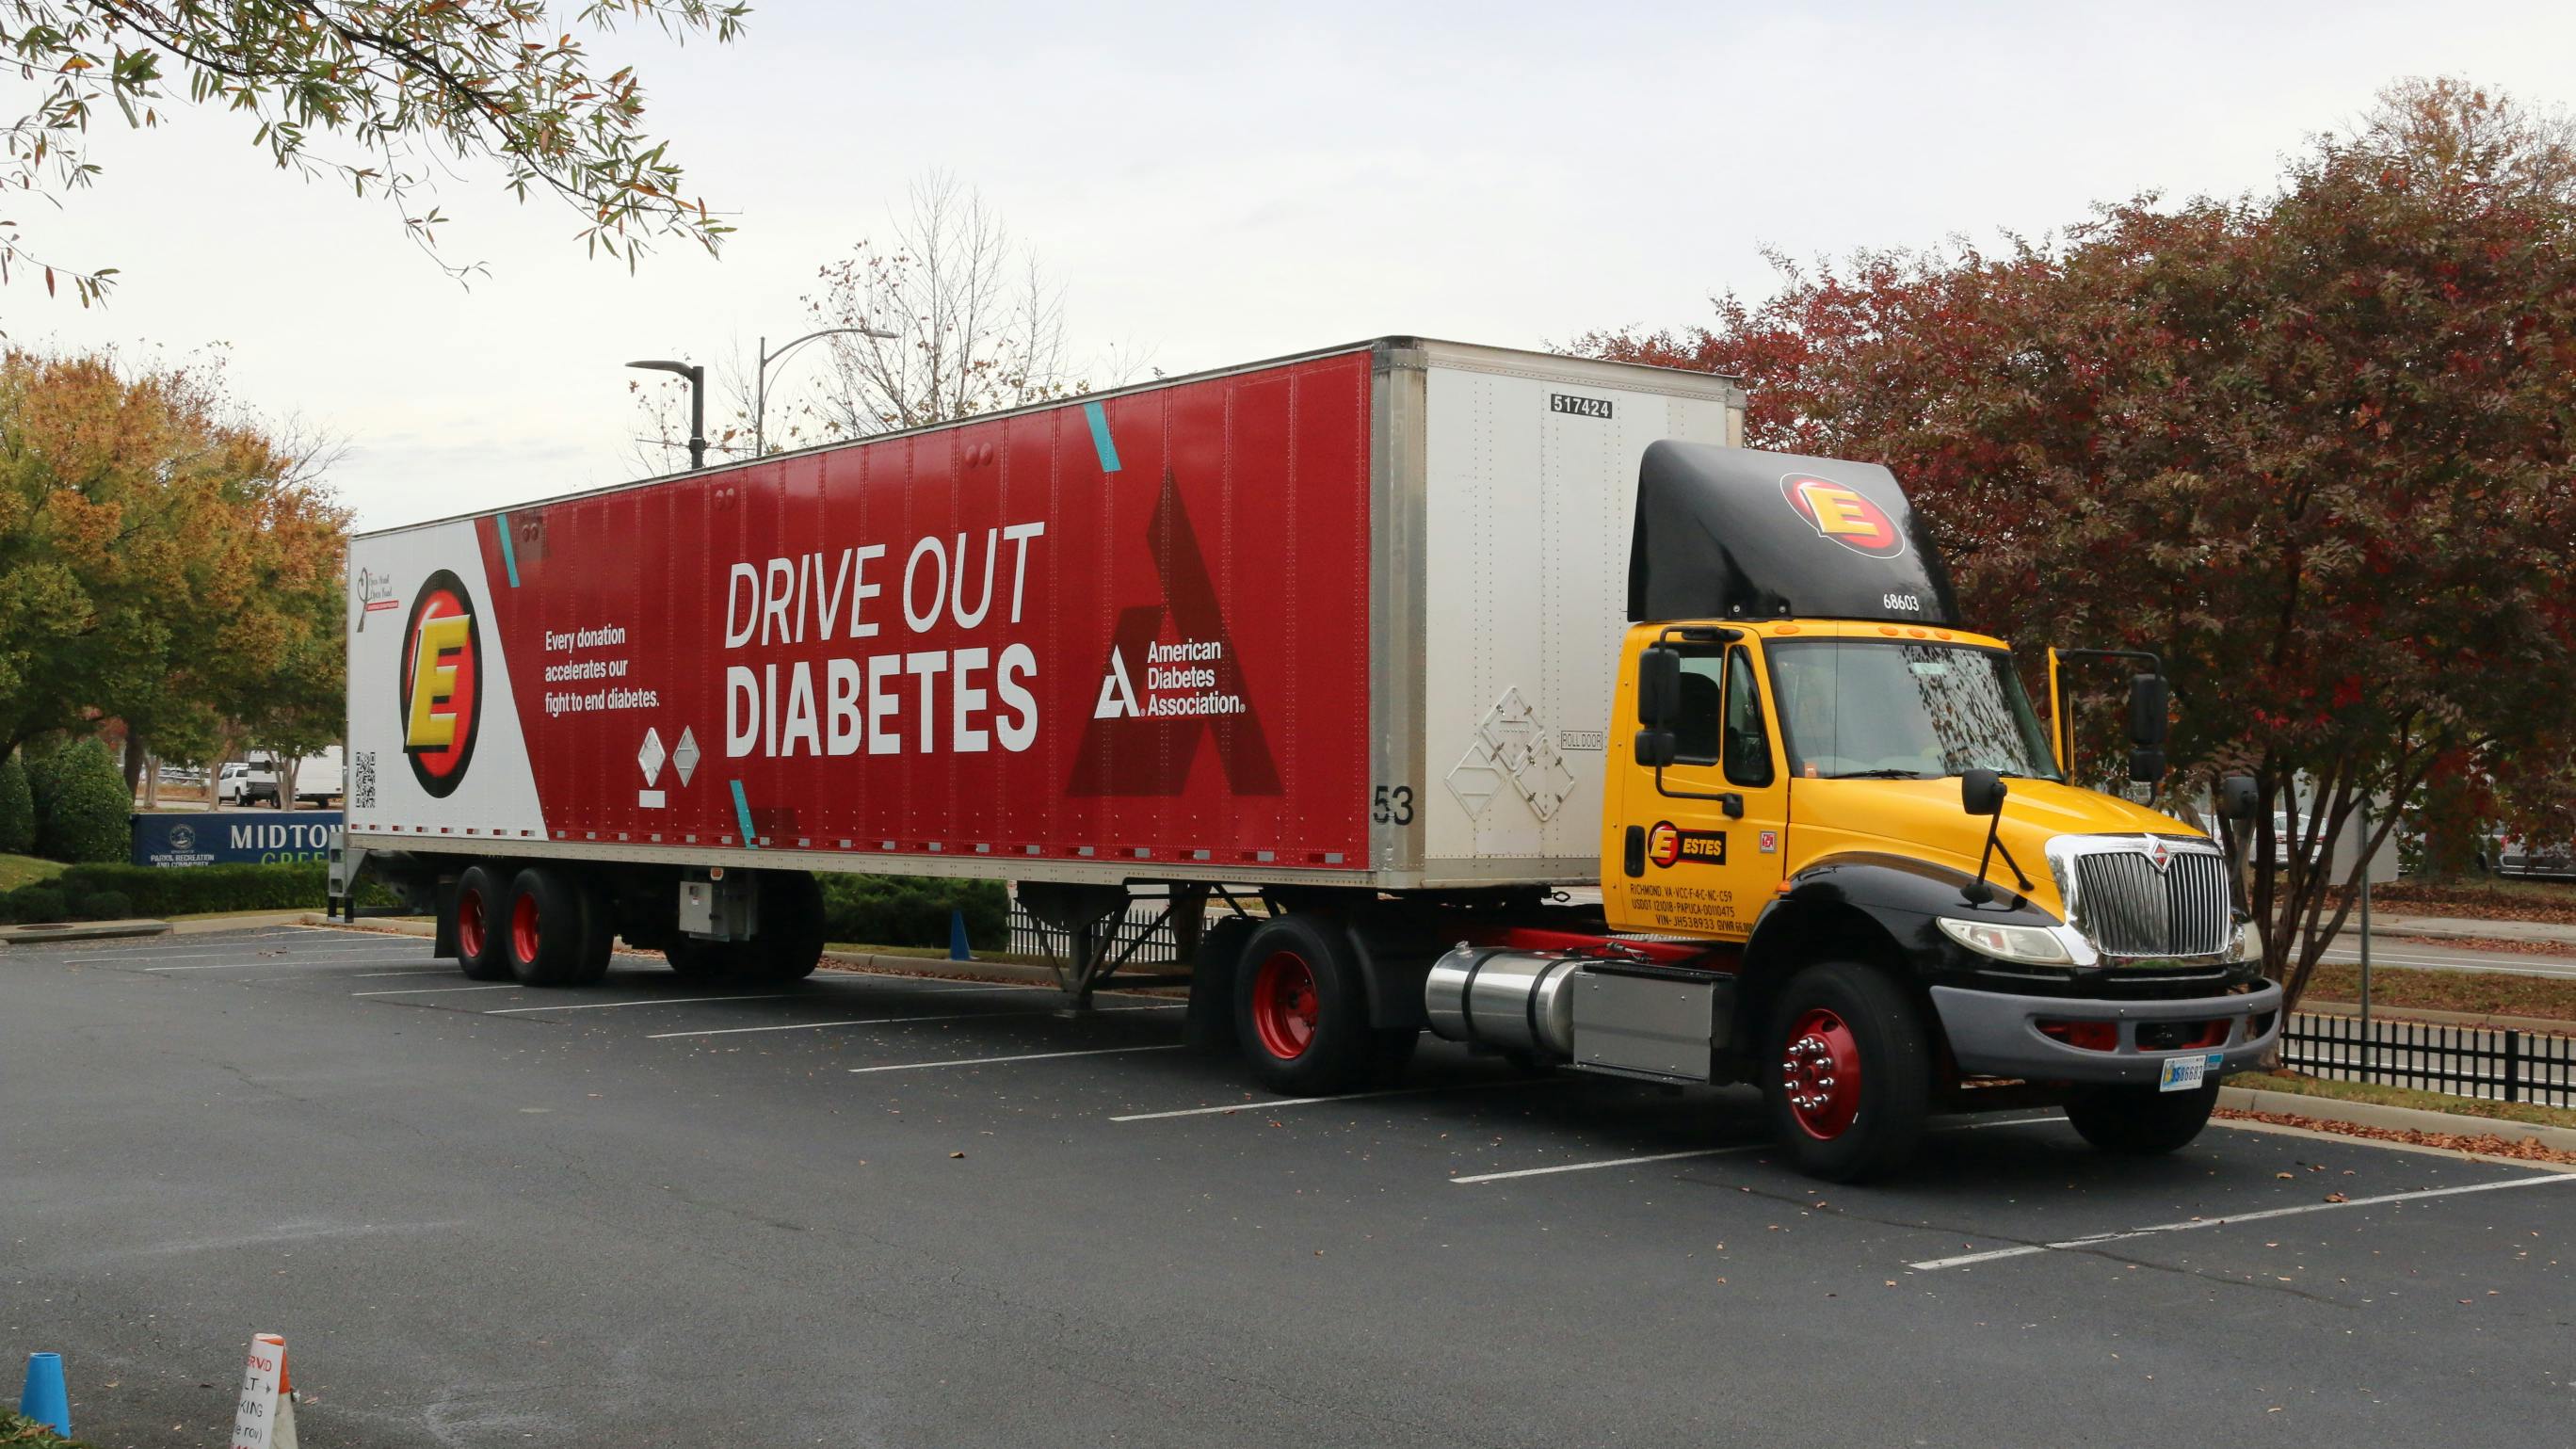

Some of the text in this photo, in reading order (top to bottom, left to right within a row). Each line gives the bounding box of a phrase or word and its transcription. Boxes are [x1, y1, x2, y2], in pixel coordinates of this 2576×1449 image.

[1554, 396, 1609, 417] 517424
[1801, 487, 1880, 536] E
[725, 521, 1045, 649] DRIVE OUT
[1883, 593, 1920, 611] 68603
[545, 623, 625, 653] Every donation
[1147, 638, 1221, 664] American
[545, 659, 628, 682] accelerates our
[1148, 666, 1216, 690] Diabetes
[403, 614, 471, 754] E
[545, 687, 660, 717] fight to end diabetes.
[726, 643, 1038, 758] DIABETES
[1562, 733, 1602, 748] ROLL DOOR
[1373, 785, 1413, 826] 53
[231, 825, 345, 849] MIDTO
[1682, 838, 1722, 856] ESTES
[1632, 899, 1651, 910] USDOT
